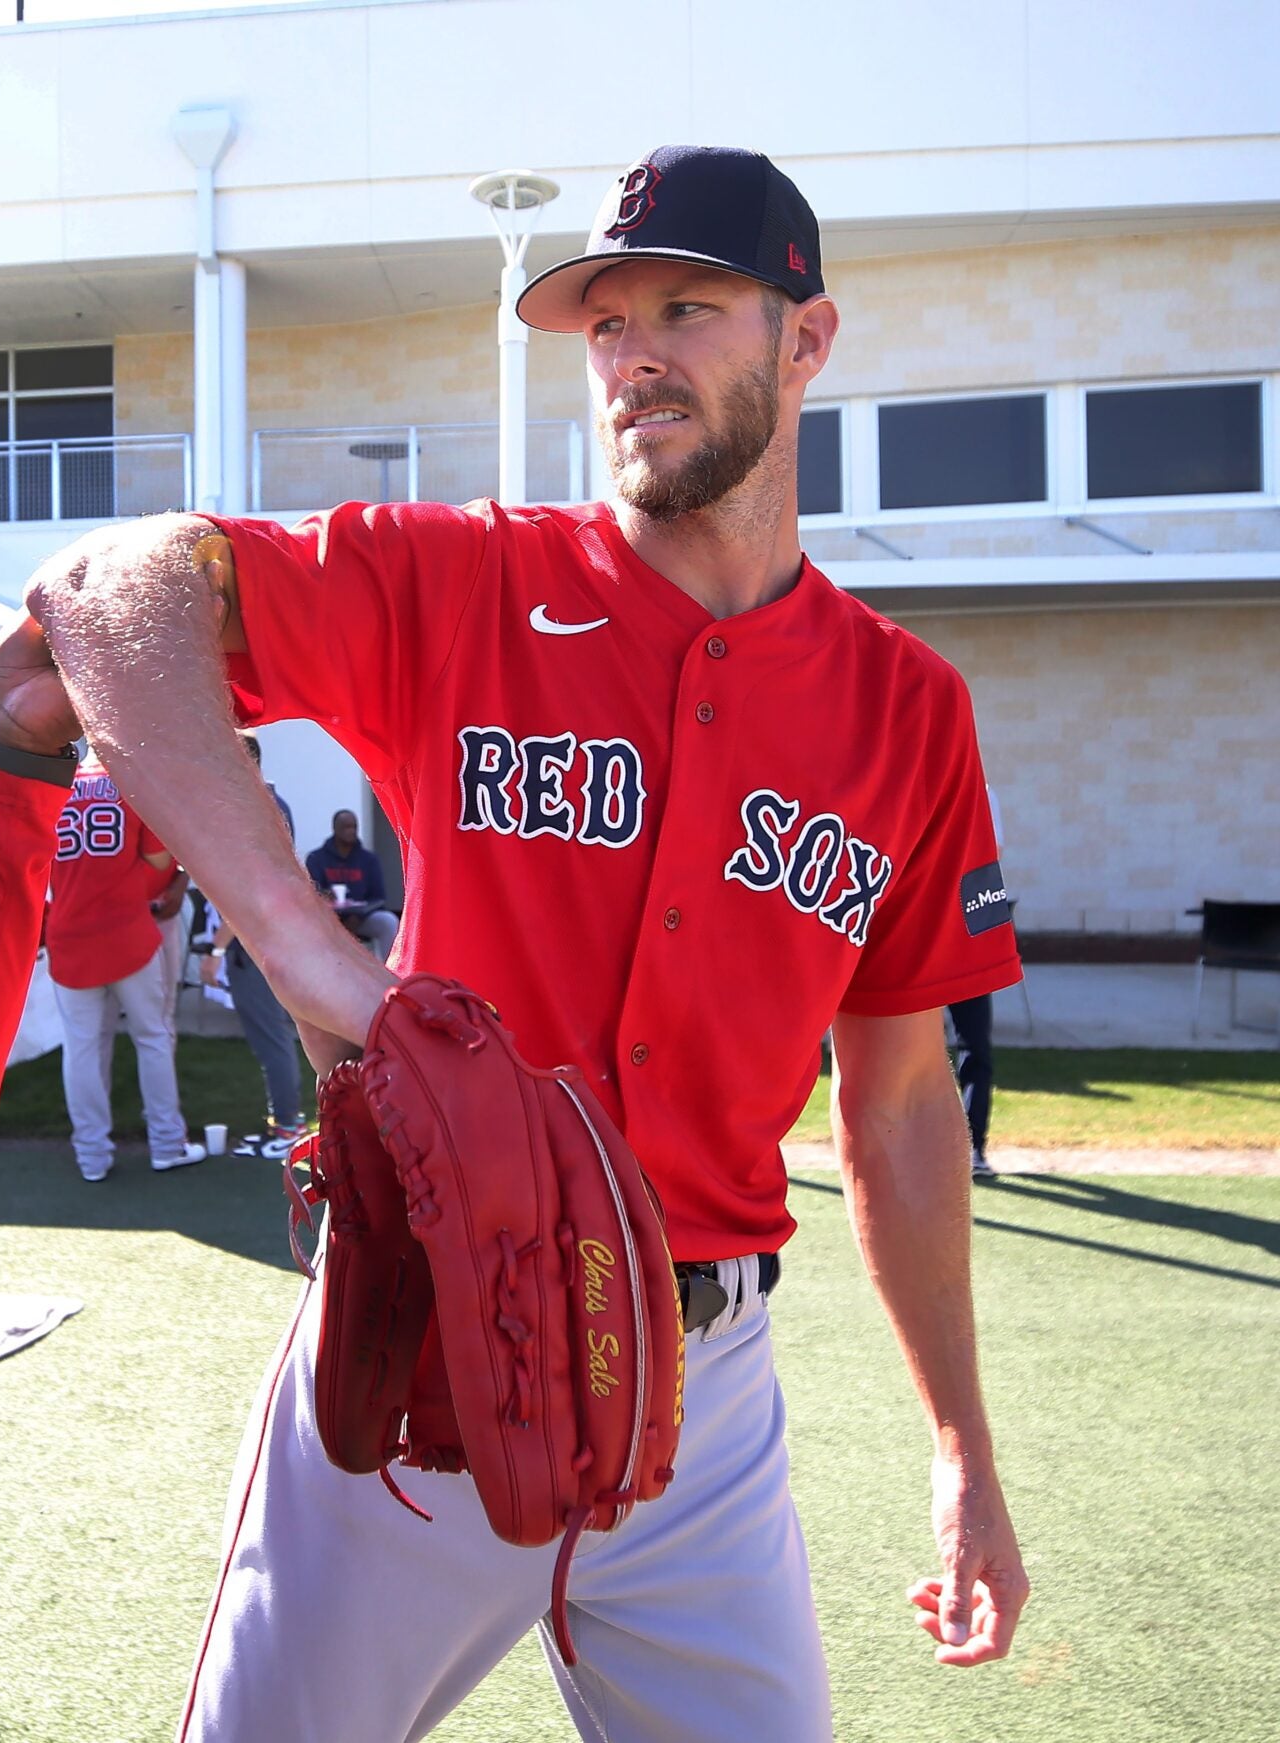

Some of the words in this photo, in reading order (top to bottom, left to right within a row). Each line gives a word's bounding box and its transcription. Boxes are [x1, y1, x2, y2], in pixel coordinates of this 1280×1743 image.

[604, 164, 662, 239] B
[456, 725, 648, 849] RED
[723, 788, 893, 947] SOX
[578, 1239, 616, 1315] Chris
[587, 1328, 620, 1398] Sale
